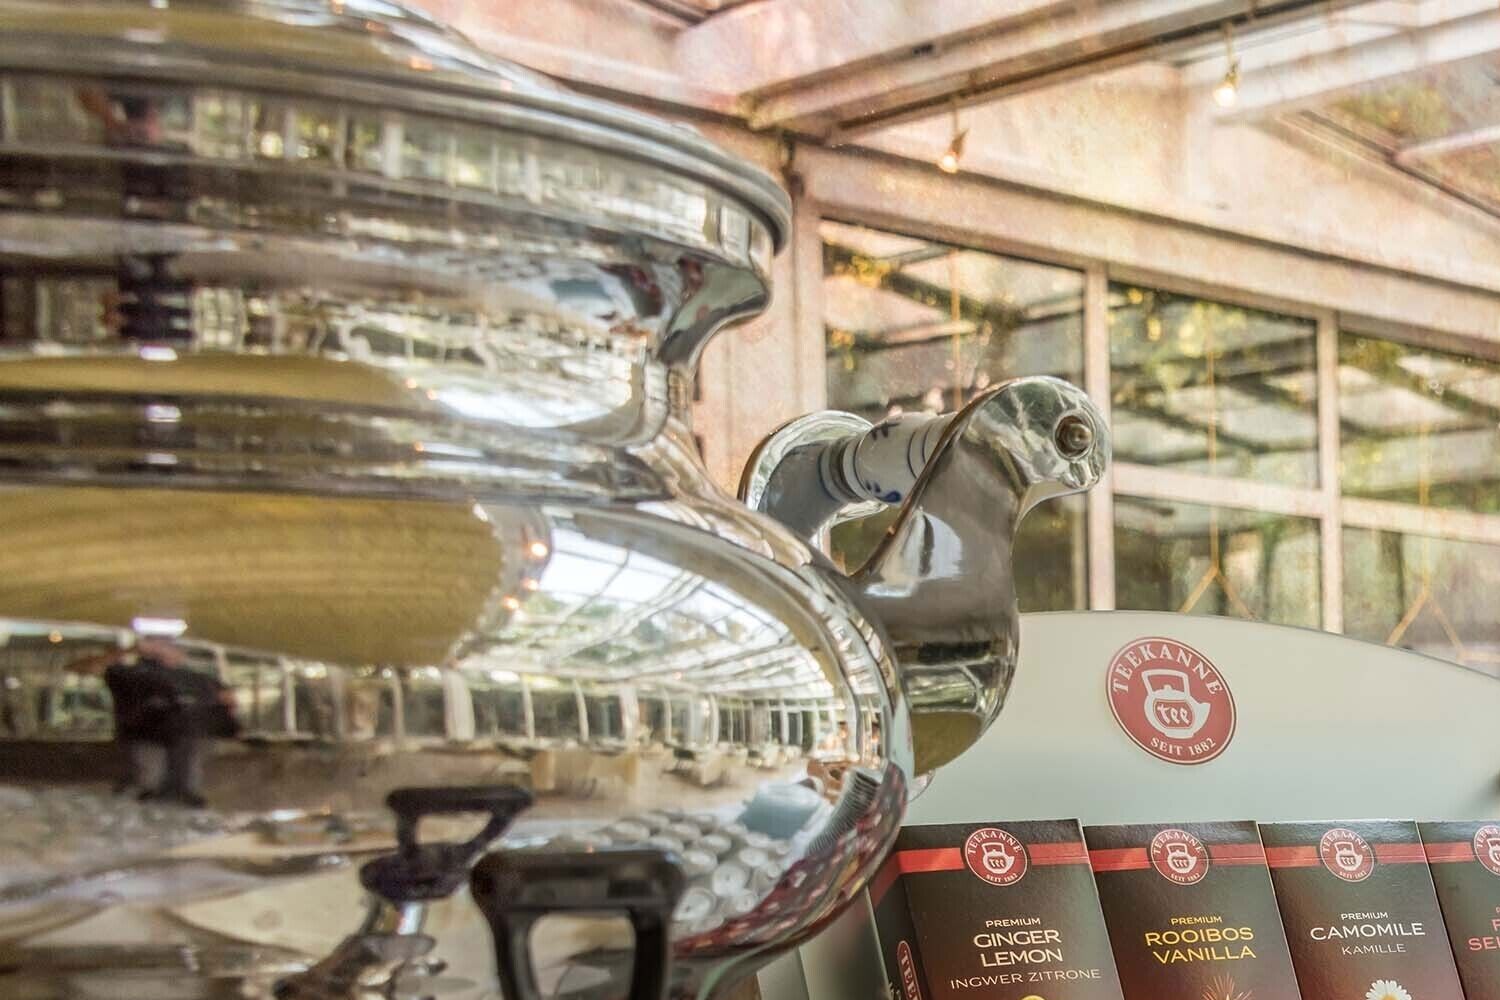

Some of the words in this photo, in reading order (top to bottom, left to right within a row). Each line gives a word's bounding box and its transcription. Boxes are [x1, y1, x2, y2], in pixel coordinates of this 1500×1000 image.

[1112, 643, 1223, 695] TEEKANNE
[1157, 703, 1190, 724] tee
[1150, 737, 1183, 756] SEIT
[1188, 737, 1217, 756] 1882
[968, 830, 1022, 856] TEEKANNE
[1153, 830, 1204, 855] TEEKANNE
[985, 917, 1041, 928] PREMIUM
[1170, 915, 1223, 926] PREMIUM
[1340, 911, 1389, 921] PREMIUM
[973, 929, 1062, 948] GINGER
[1144, 927, 1255, 947] ROOIBOS
[1310, 922, 1426, 941] CAMOMILE
[980, 948, 1064, 967] LEMON
[1152, 945, 1257, 964] VANILLA
[1341, 943, 1407, 956] KAMILLE
[950, 972, 1024, 990] INGWER
[1028, 968, 1102, 983] ZITRONE
